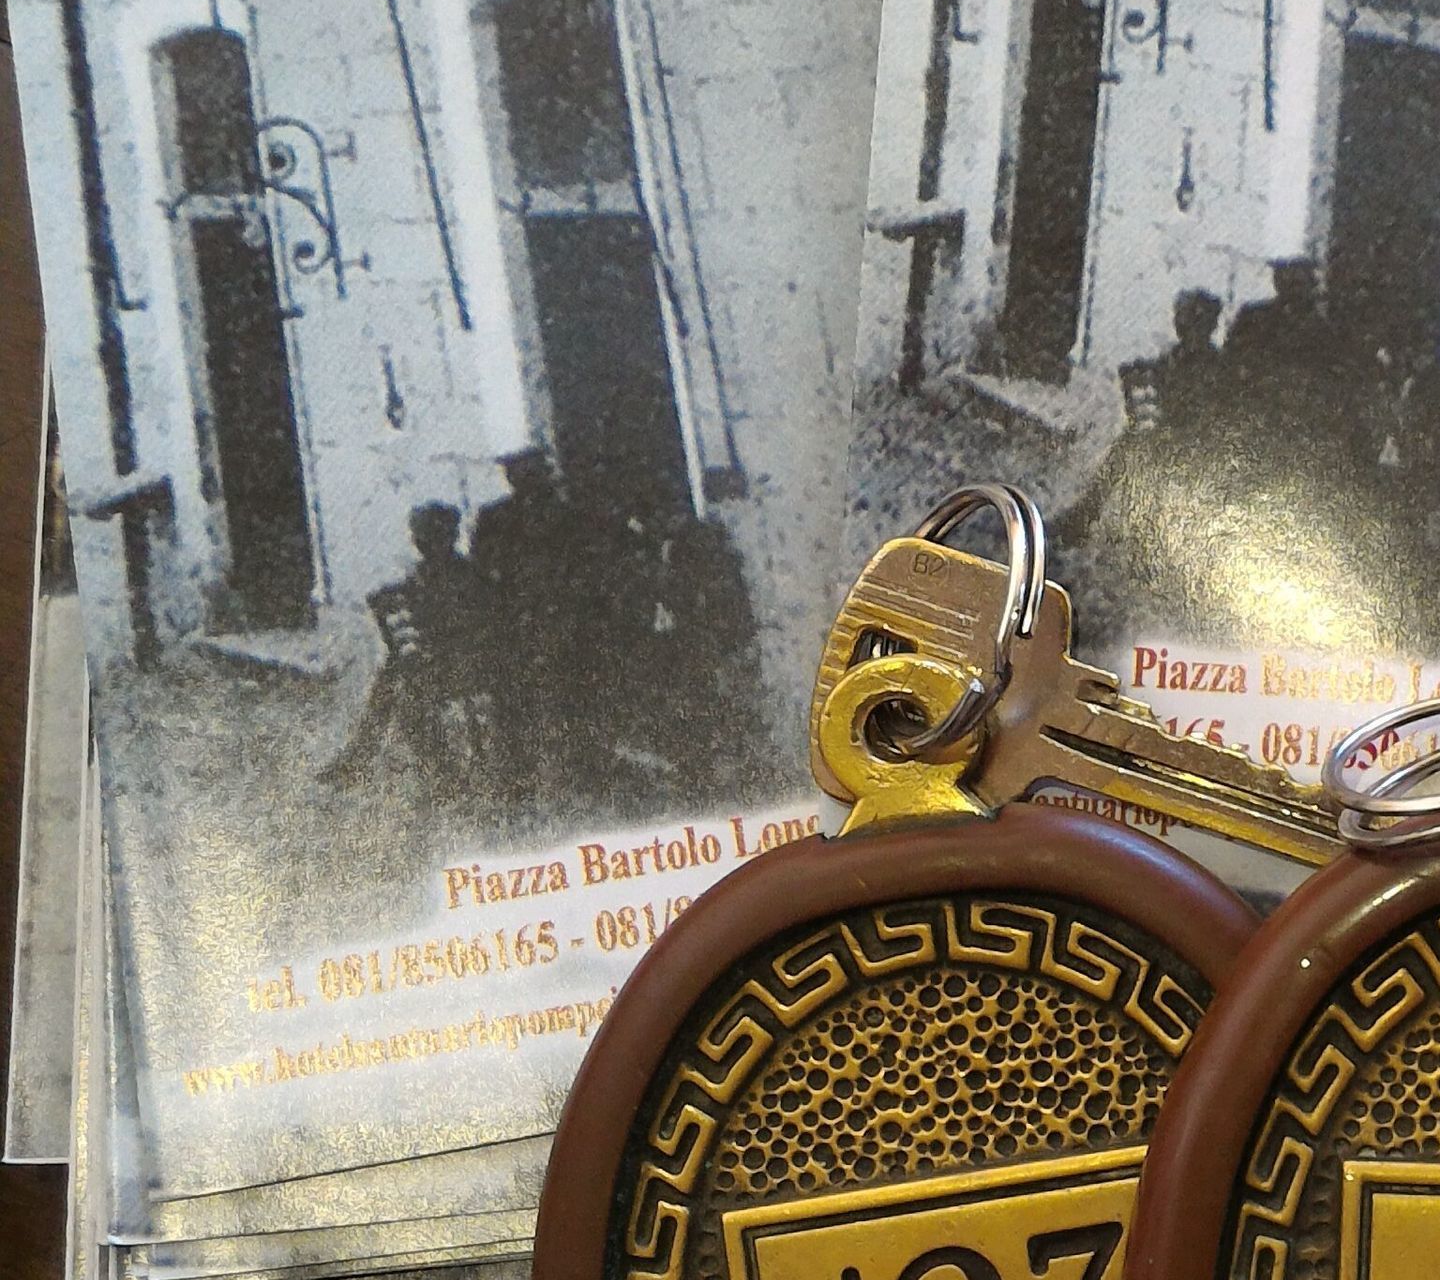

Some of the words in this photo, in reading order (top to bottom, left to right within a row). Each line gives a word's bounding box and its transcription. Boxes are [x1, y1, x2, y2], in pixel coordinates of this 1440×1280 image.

[1132, 647, 1247, 694] Piazza
[444, 860, 568, 910] Piazza
[577, 825, 722, 885] Bartolo
